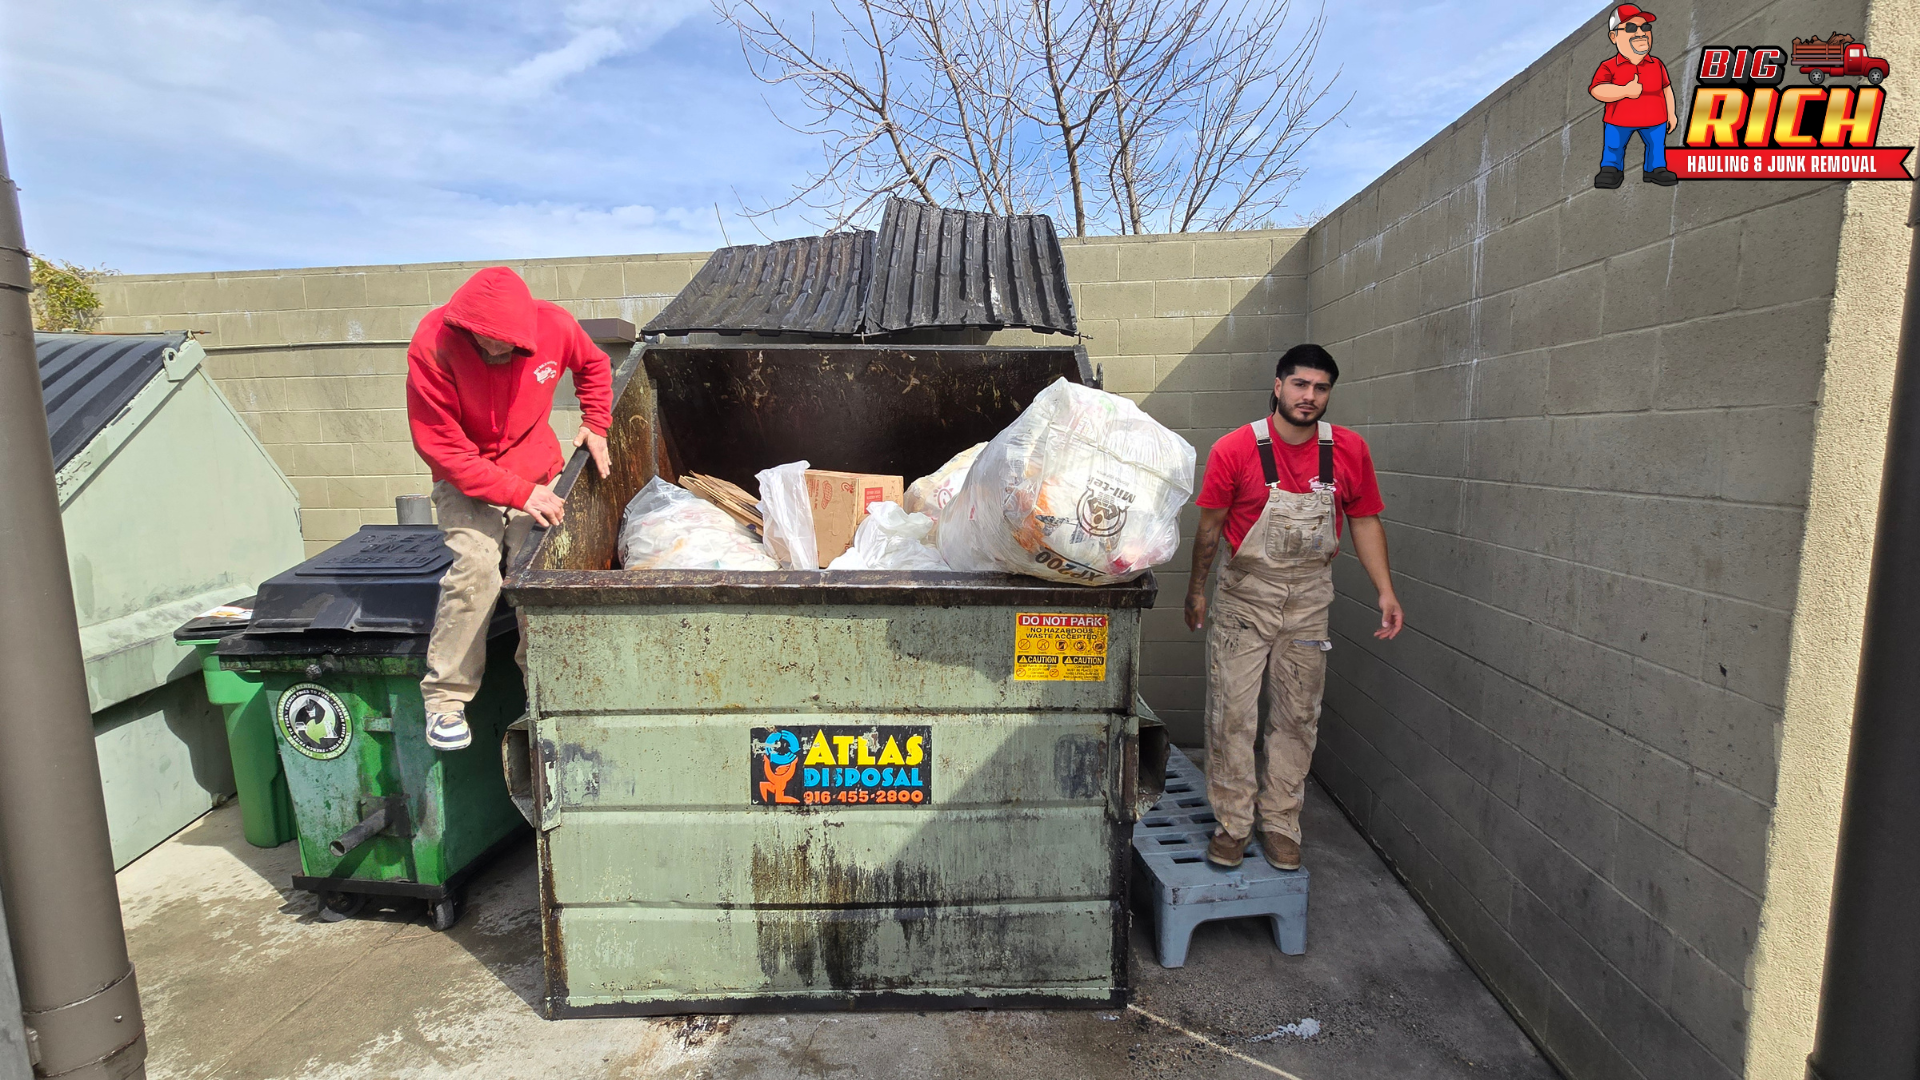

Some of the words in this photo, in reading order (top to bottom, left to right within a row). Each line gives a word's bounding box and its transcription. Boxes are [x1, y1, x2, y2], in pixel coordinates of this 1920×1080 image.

[1035, 551, 1104, 582] XP200
[1022, 616, 1040, 625] DO
[1042, 616, 1068, 626] NOT
[1070, 617, 1103, 627] PARK
[1027, 656, 1057, 664] CAUTION
[1072, 656, 1103, 665] CAUTION
[803, 728, 924, 766] ATLAS
[803, 767, 924, 788] DISPOSAL
